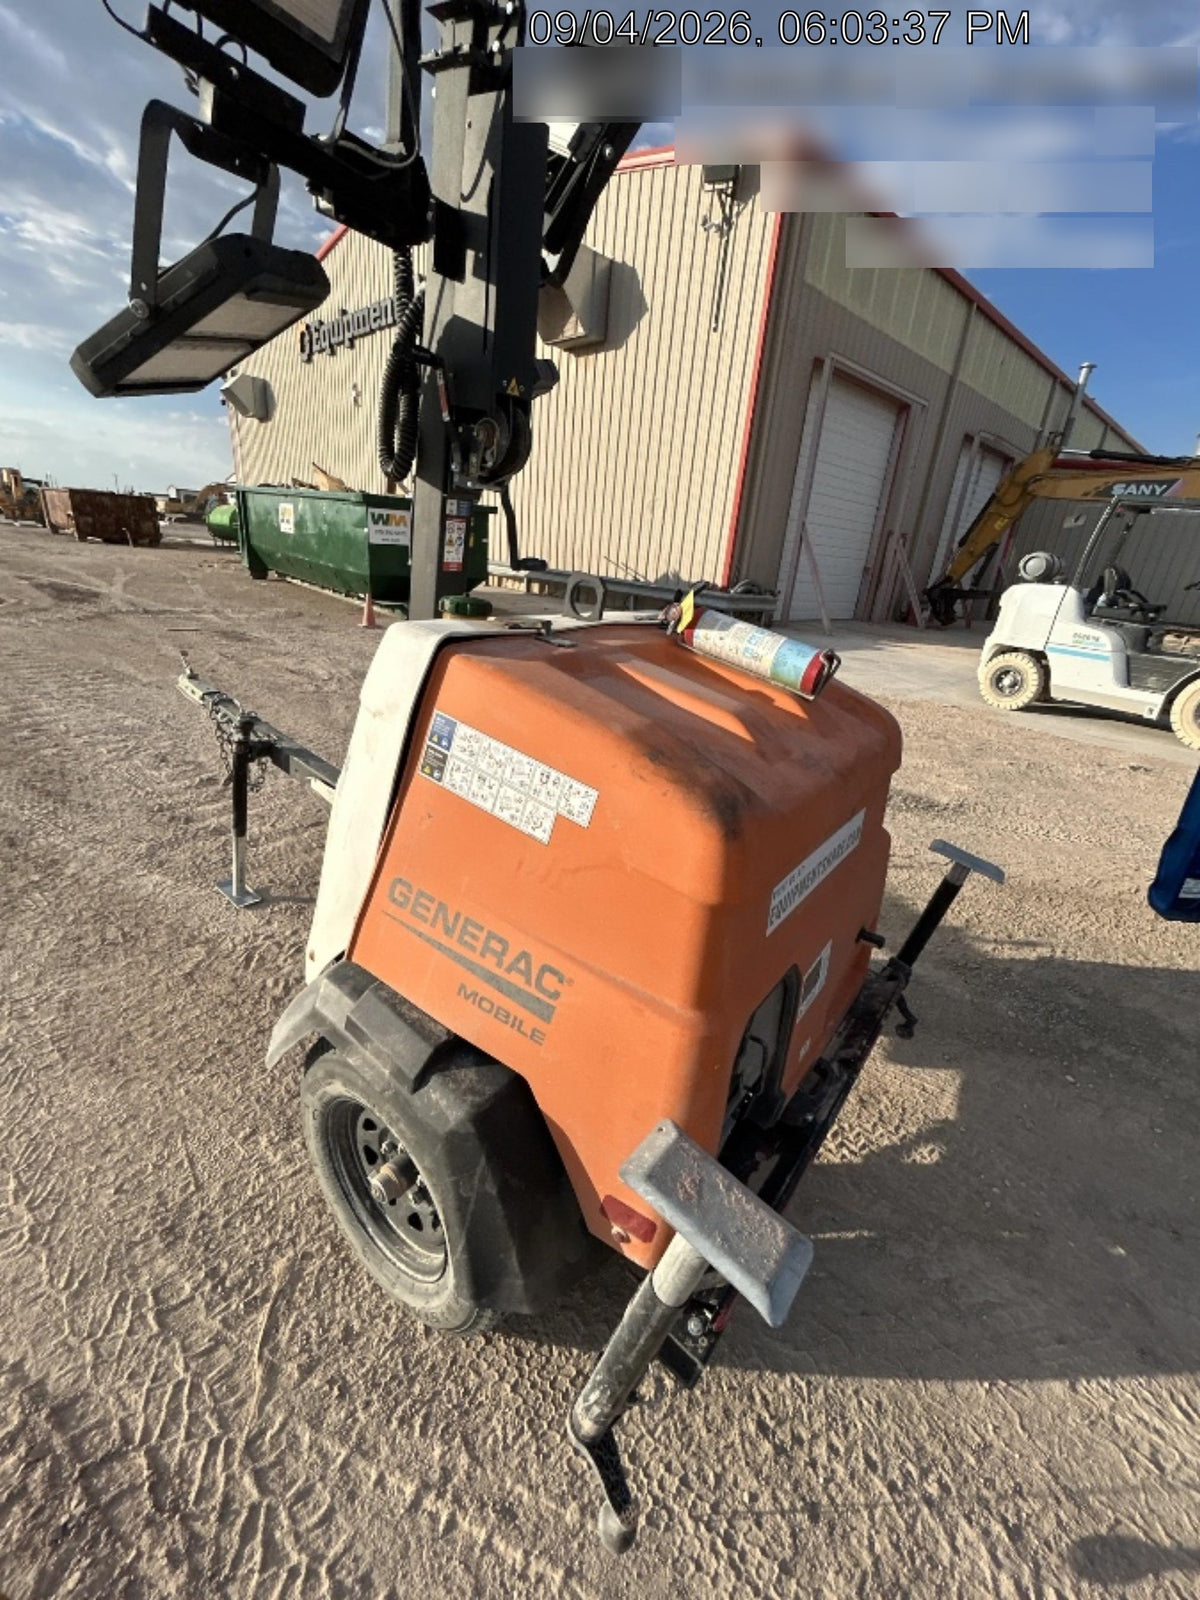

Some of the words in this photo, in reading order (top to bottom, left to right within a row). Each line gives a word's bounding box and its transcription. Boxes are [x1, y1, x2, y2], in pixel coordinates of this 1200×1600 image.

[1111, 483, 1168, 496] SANY
[370, 511, 407, 527] WM
[387, 876, 567, 1001] GENERAC
[456, 982, 547, 1047] MOBILE
